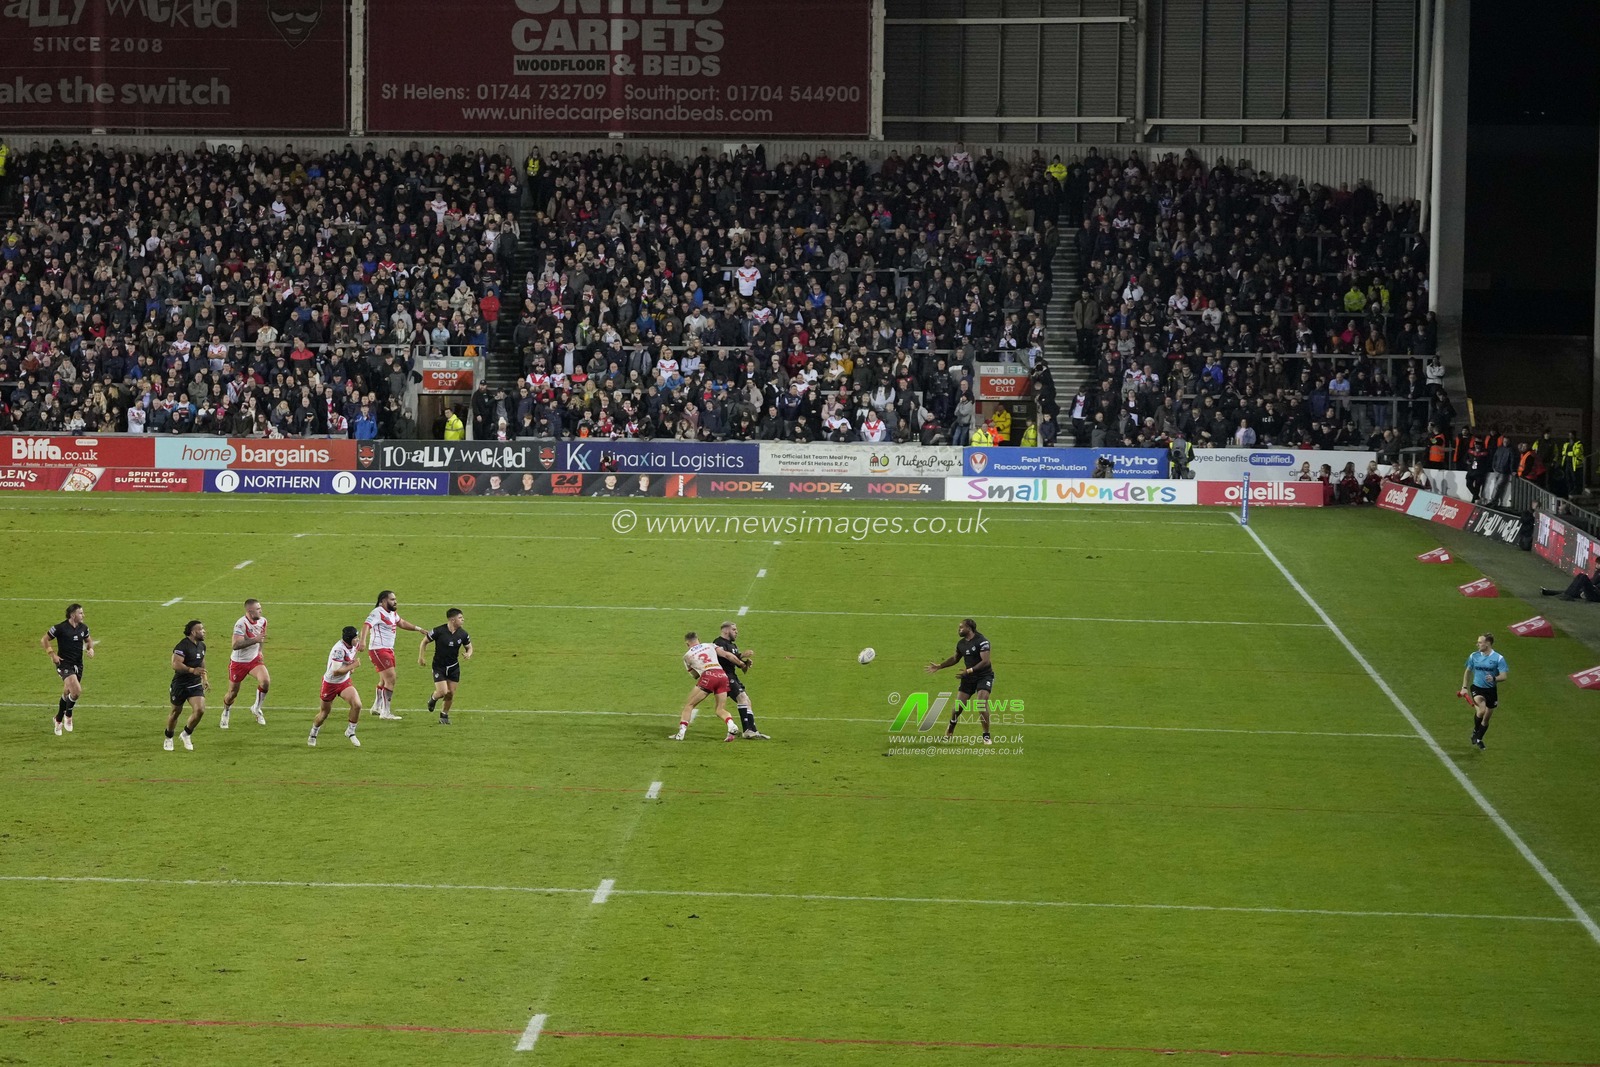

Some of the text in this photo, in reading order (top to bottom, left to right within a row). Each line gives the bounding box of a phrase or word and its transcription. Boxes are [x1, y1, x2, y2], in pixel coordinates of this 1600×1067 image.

[511, 18, 725, 52] CARPETS
[33, 37, 164, 54] SINCE 2008
[516, 59, 606, 72] WOODFLOOR
[612, 54, 721, 77] & BEDS
[0, 76, 231, 105] ake the switch
[381, 84, 861, 103] St Helens: 01744 732709 Southport: 01704 544900
[461, 104, 773, 123] www.unitedcarpetsandbeds.com
[11, 437, 98, 461] Biffa.co.uk
[181, 444, 329, 467] home bargains
[671, 451, 744, 471] Logistics
[1112, 455, 1158, 467] Hytro
[1215, 454, 1248, 463] benefits
[1250, 453, 1293, 465] simplified.
[993, 463, 1087, 472] Recovery Revolution
[0, 469, 38, 483] LEN'S
[244, 475, 321, 489] NORTHERN
[554, 474, 579, 486] 24
[361, 477, 437, 490] NORTHERN
[552, 486, 582, 494] AWAY
[710, 481, 775, 493] NODE4
[789, 481, 853, 493] NODE4
[868, 482, 932, 494] NODE4
[967, 477, 1177, 503] Small Wonders
[698, 653, 712, 664] 2
